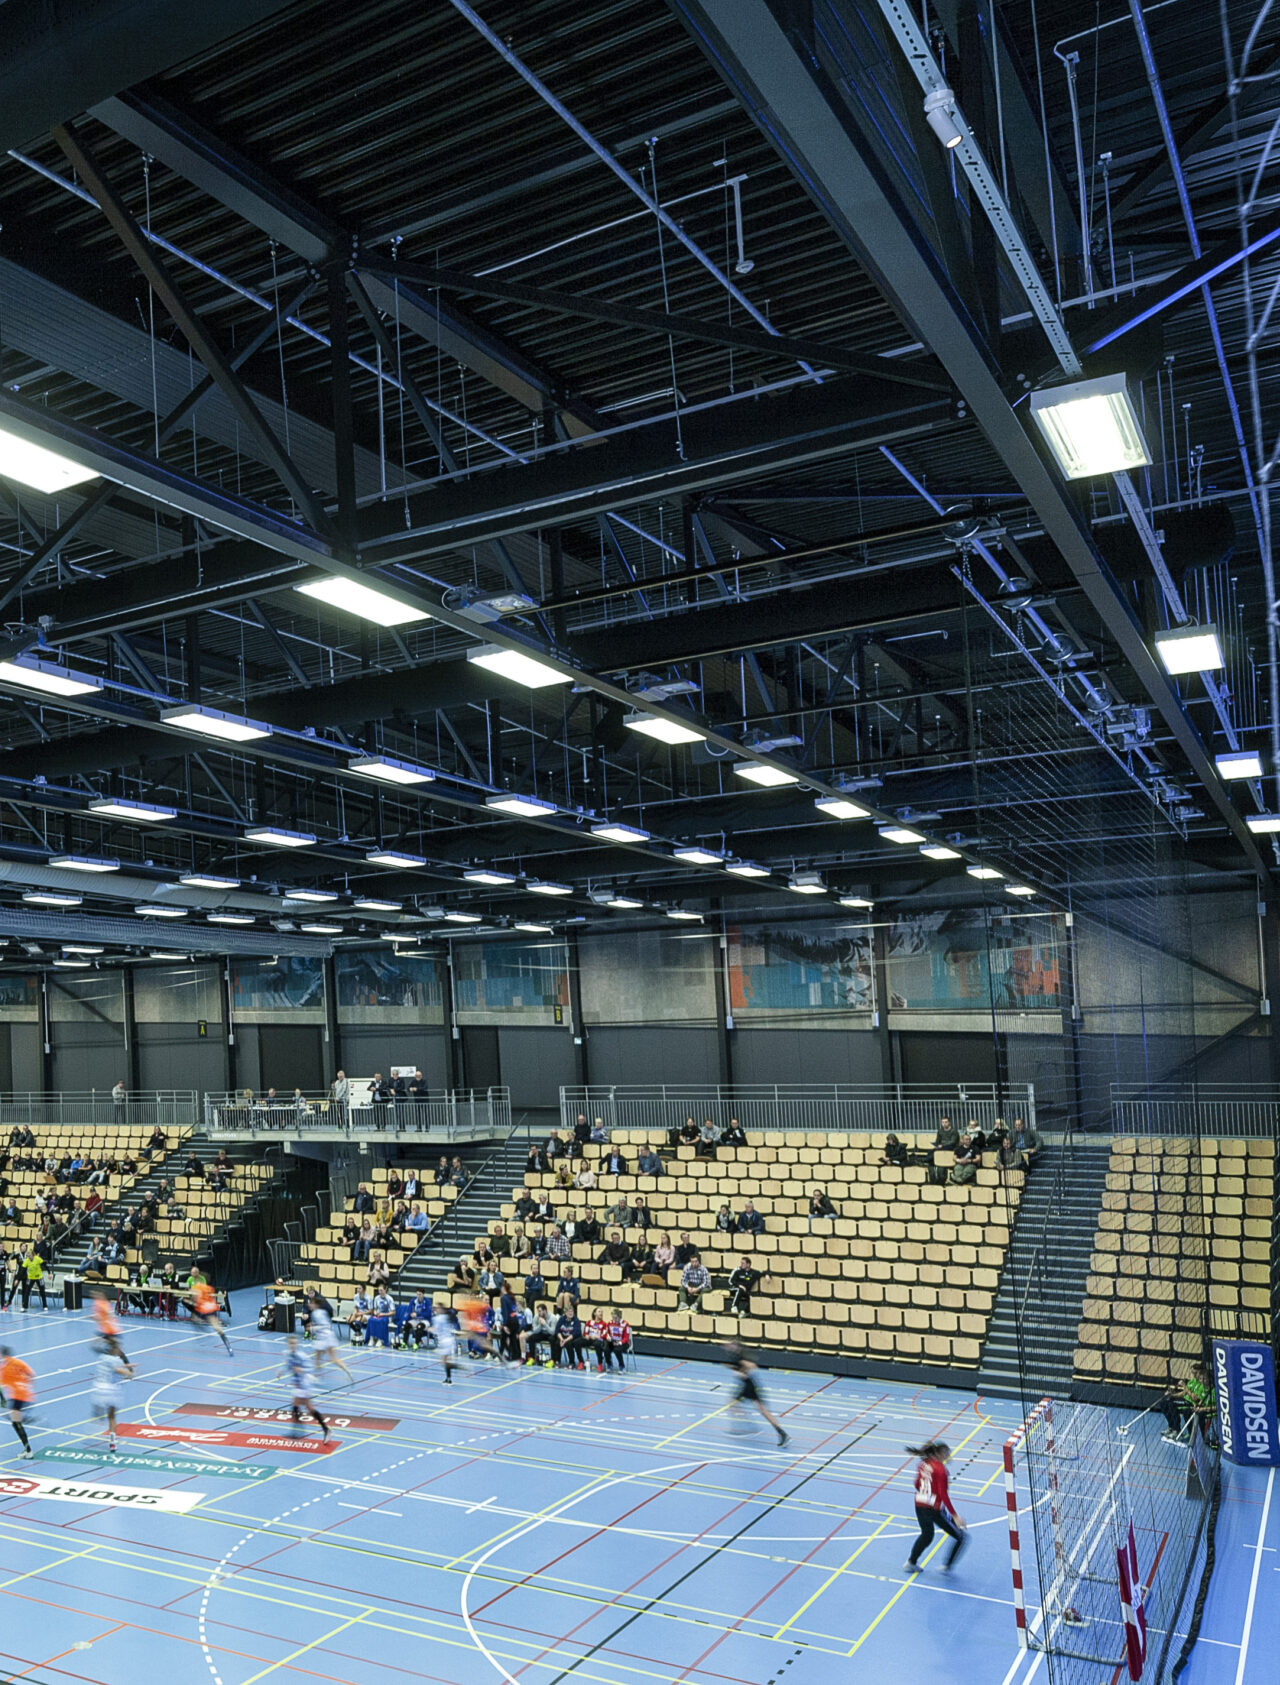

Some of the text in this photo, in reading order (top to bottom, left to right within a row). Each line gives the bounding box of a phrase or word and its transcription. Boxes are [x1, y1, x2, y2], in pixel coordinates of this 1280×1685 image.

[1216, 1347, 1233, 1455] DAVIDSEN
[1240, 1352, 1272, 1459] DAVIDSEN
[216, 1409, 351, 1428] broager
[45, 1450, 269, 1478] JydskeVestkysten
[39, 1486, 163, 1505] SPORT
